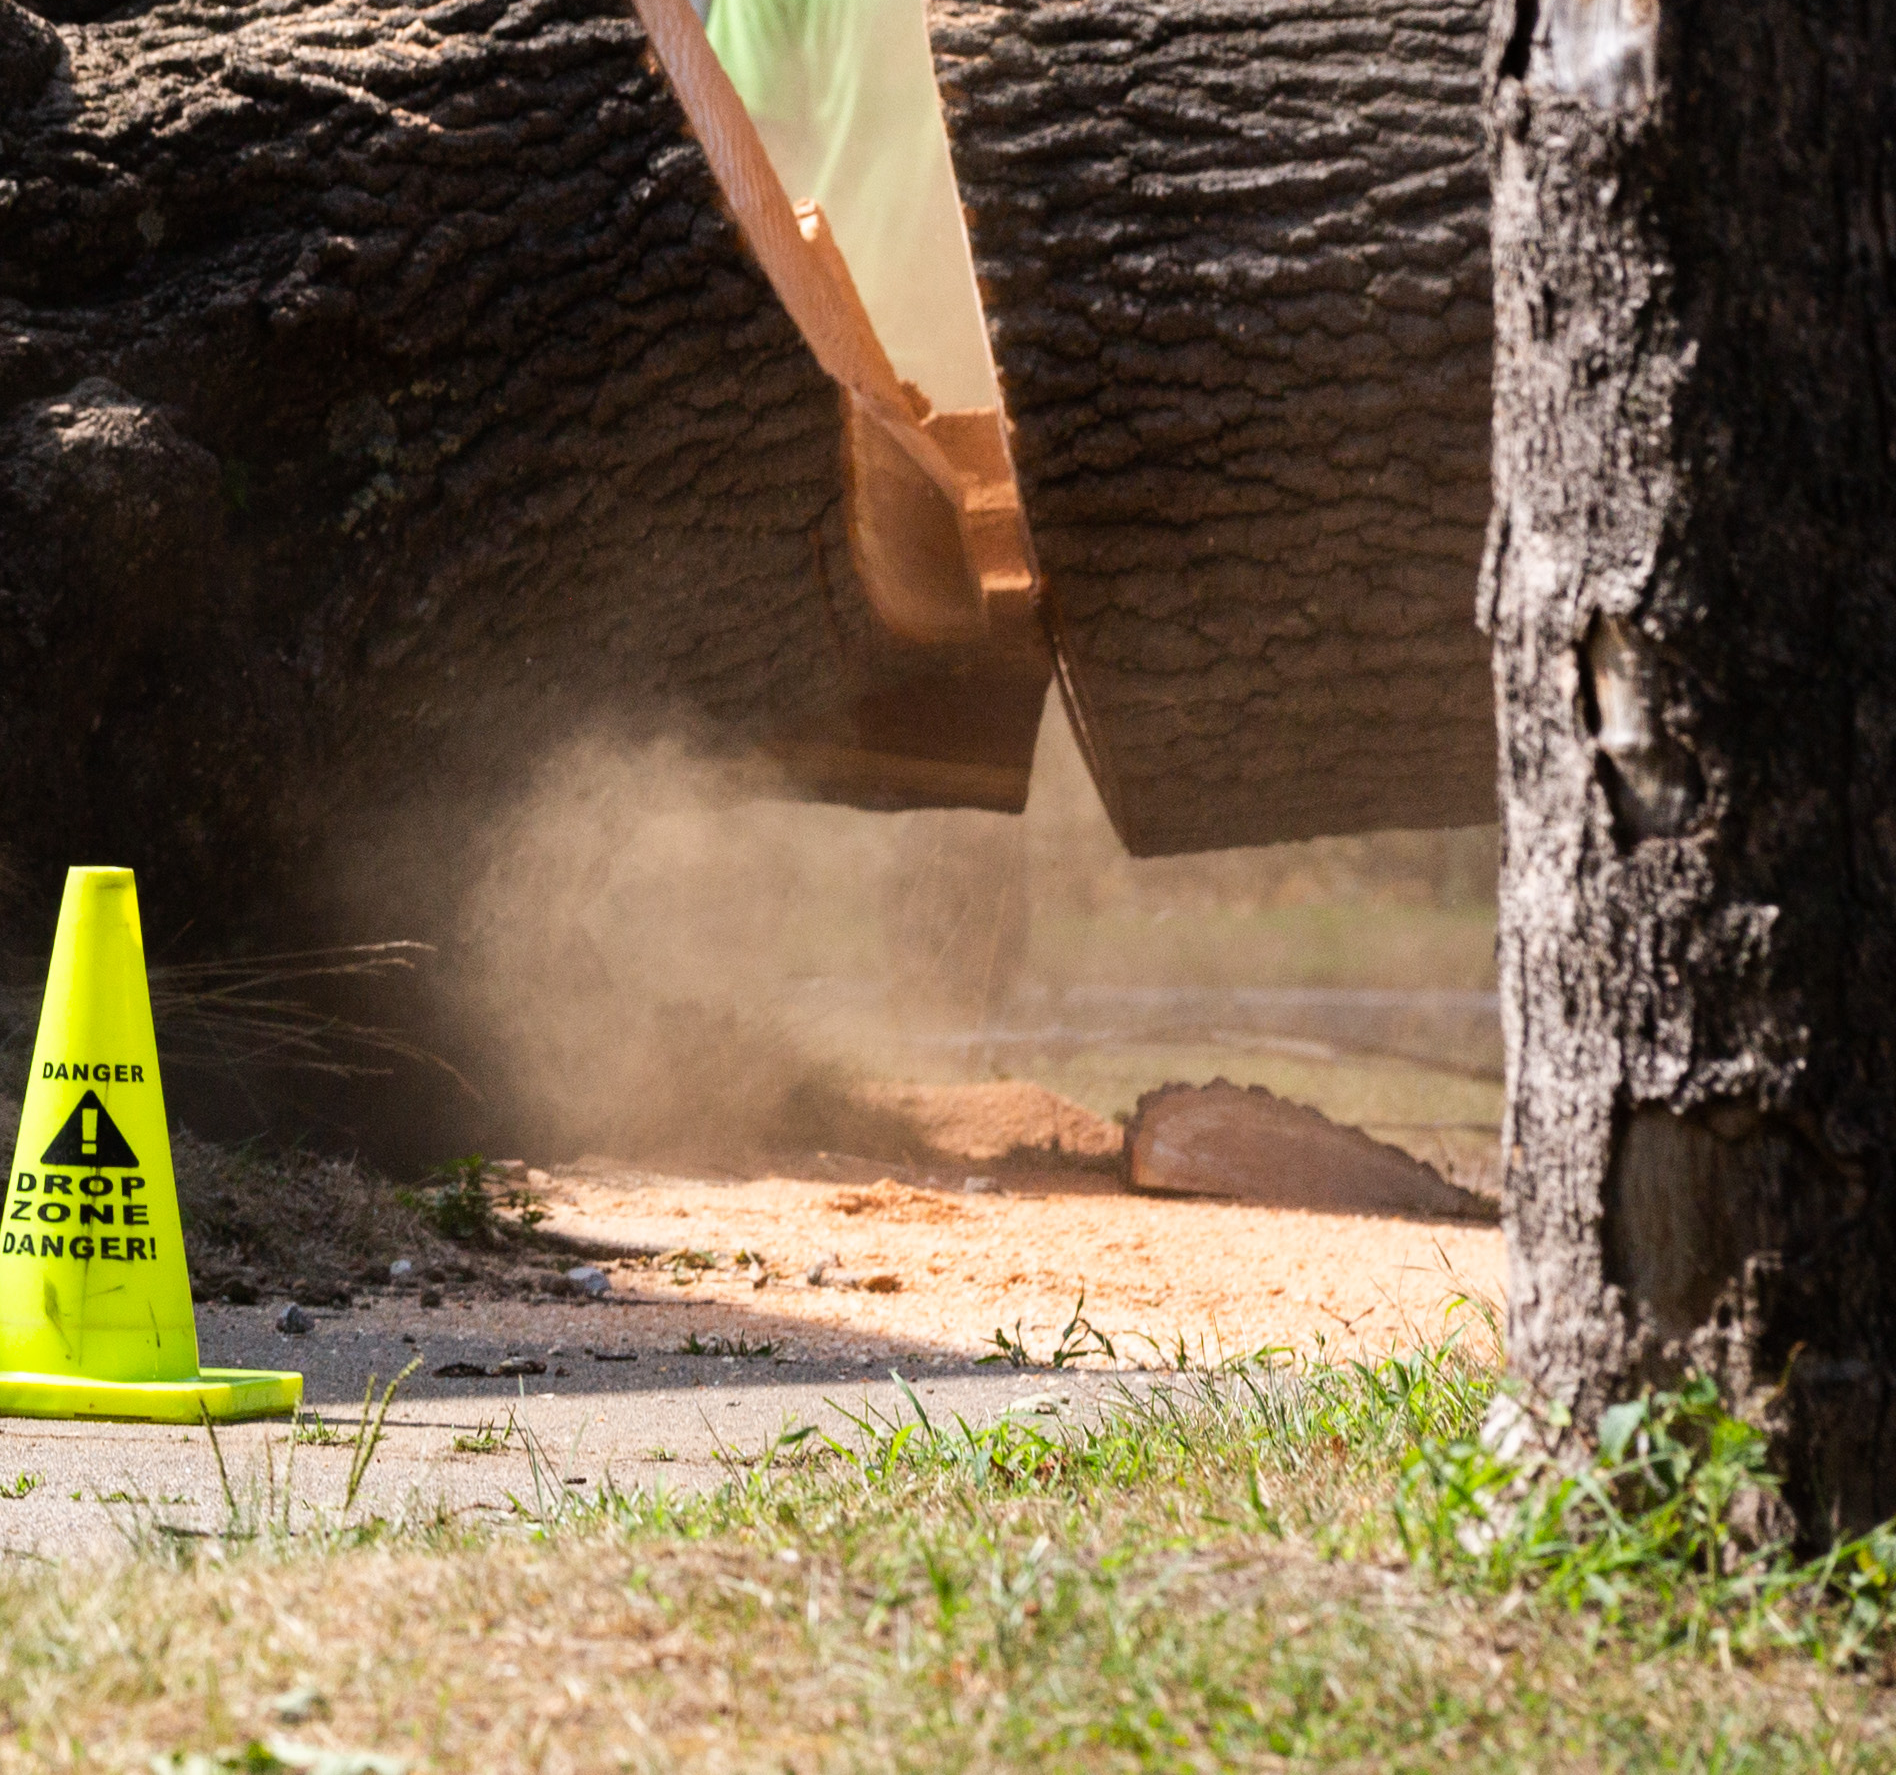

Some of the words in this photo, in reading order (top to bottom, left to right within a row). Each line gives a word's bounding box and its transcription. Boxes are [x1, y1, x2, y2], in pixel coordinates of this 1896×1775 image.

[42, 1062, 144, 1082] DANGER
[16, 1172, 145, 1196] DROP
[10, 1200, 149, 1225] ZONE
[2, 1232, 157, 1260] DANGER!
